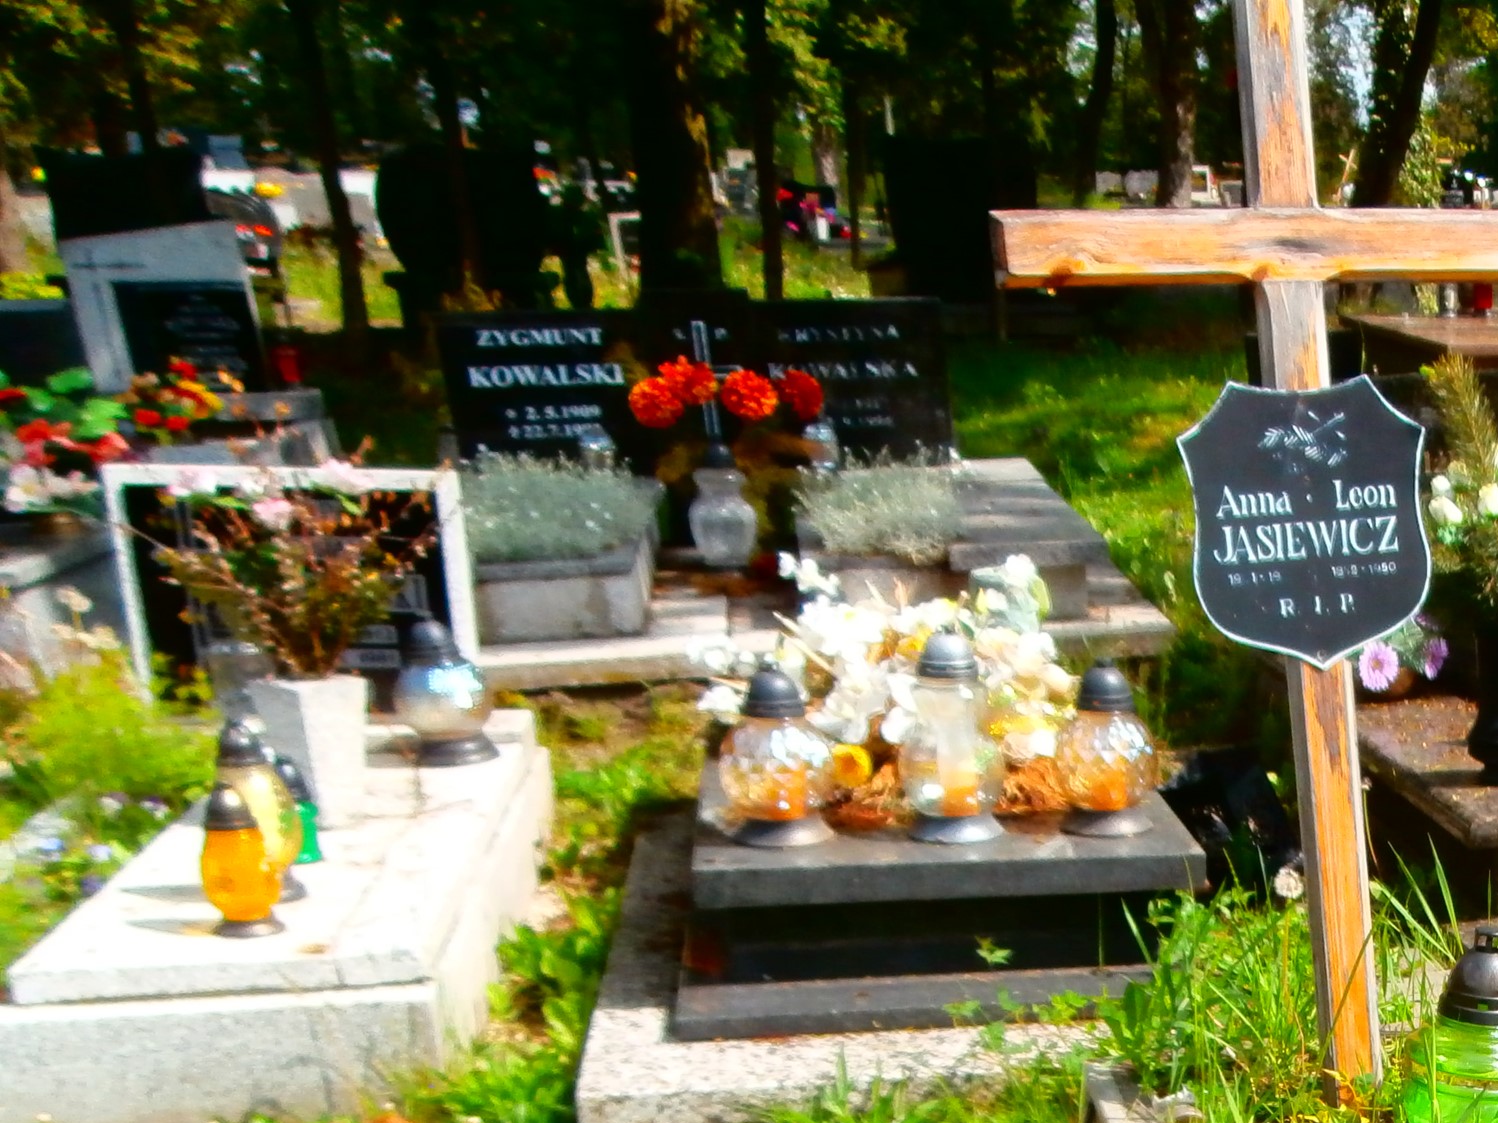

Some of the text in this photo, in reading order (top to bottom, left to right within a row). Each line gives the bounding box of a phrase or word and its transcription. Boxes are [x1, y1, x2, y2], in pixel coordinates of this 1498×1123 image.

[476, 327, 602, 347] ZYGMUNT
[467, 363, 625, 388] KOWALSKI
[1216, 479, 1397, 520] Anna Leon
[1213, 515, 1399, 564] JASIEWICZ
